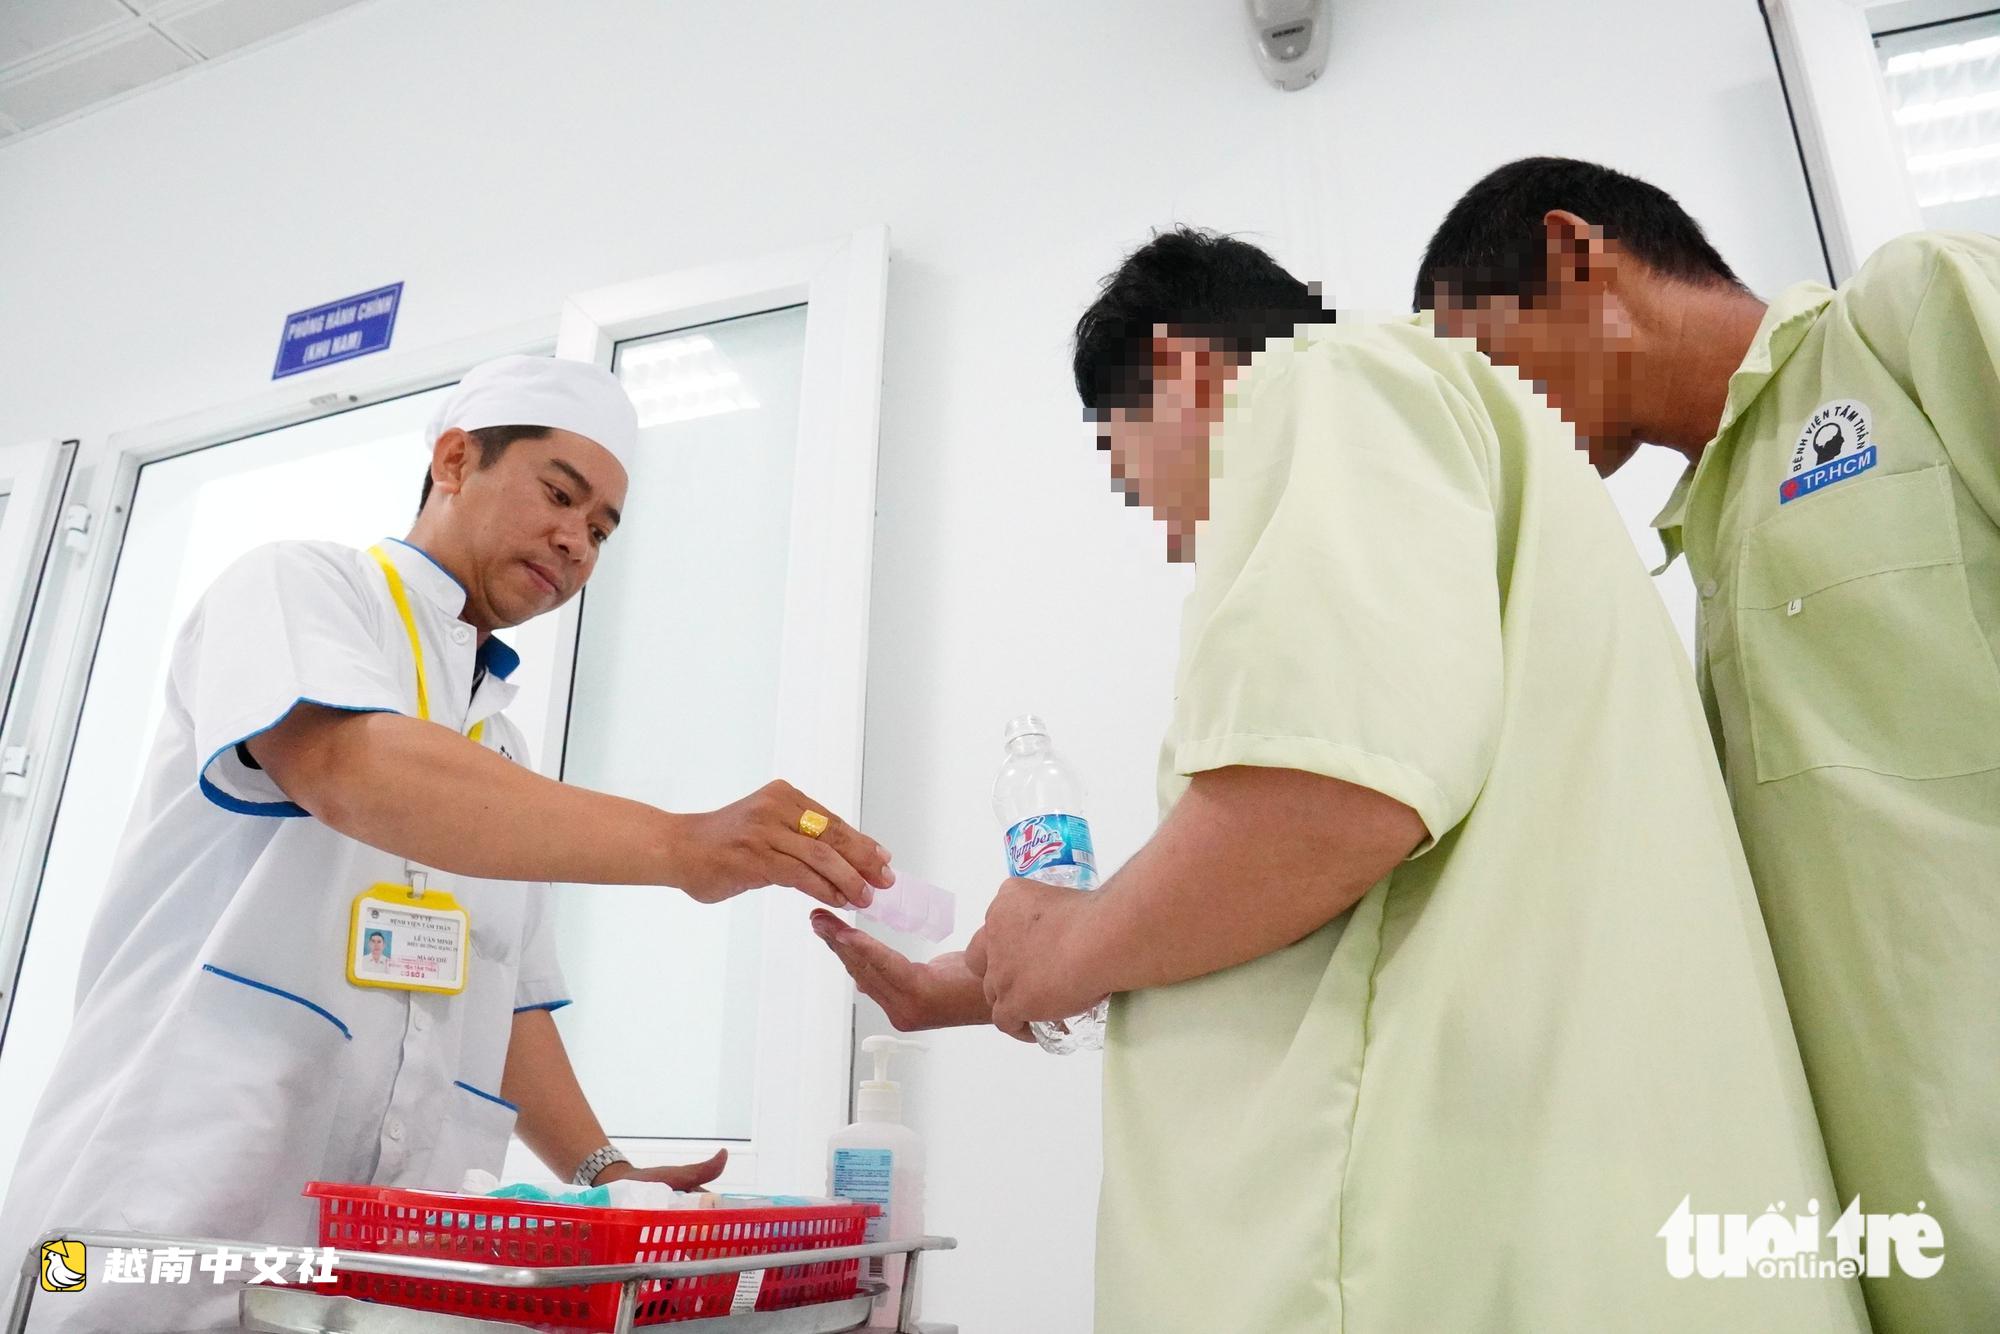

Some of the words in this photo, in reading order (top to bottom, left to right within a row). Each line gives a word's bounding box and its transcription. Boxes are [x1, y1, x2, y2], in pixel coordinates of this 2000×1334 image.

[1792, 438, 1808, 472] BỆNH
[1806, 409, 1830, 435] VIỆN
[1834, 404, 1859, 422] TÂM
[1803, 450, 1871, 489] TP.HCM
